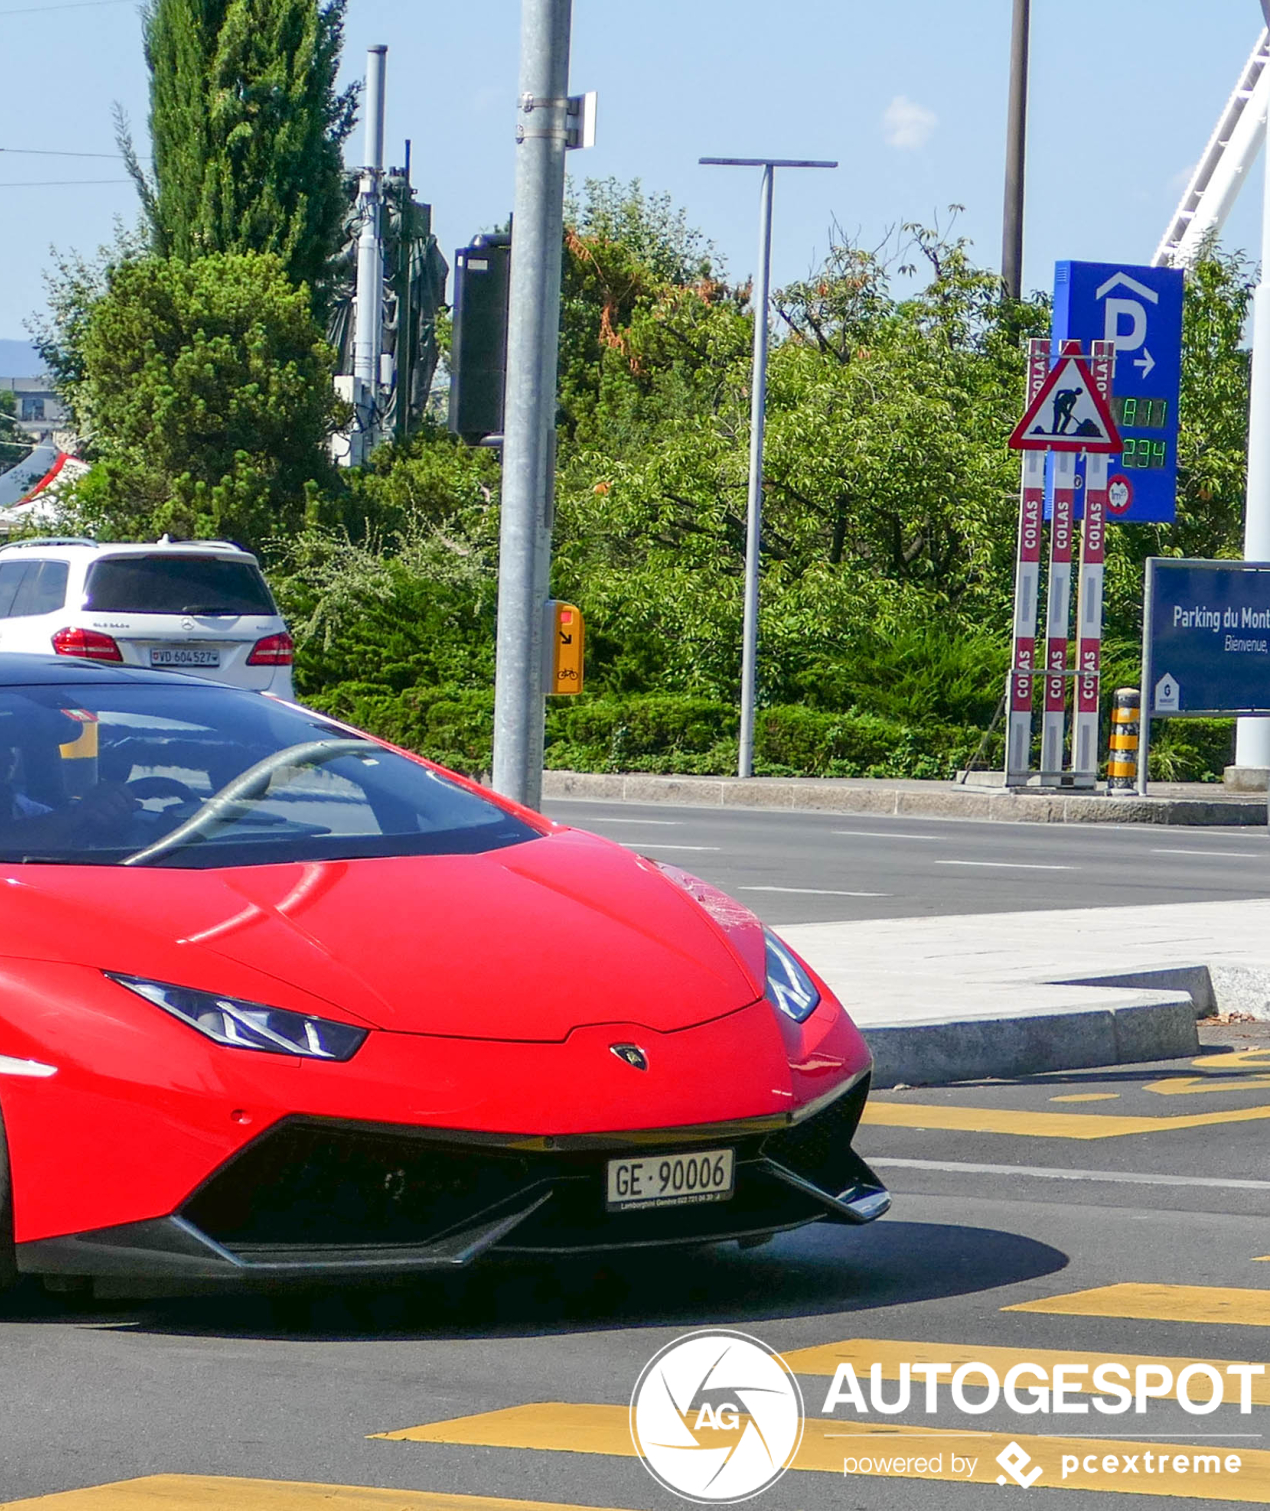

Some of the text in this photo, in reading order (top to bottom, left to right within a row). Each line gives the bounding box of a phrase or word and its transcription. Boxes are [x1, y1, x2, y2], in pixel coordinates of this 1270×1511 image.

[1104, 298, 1148, 352] P
[1123, 398, 1167, 427] 811
[1122, 438, 1166, 468] 234
[1025, 501, 1038, 549] COLAS
[1056, 502, 1069, 549] COLAS
[1089, 503, 1102, 550] COLAS
[1173, 605, 1220, 633] Parking
[1224, 606, 1238, 629] du
[160, 651, 212, 663] VD 604527
[1224, 634, 1269, 654] Bienvenue,
